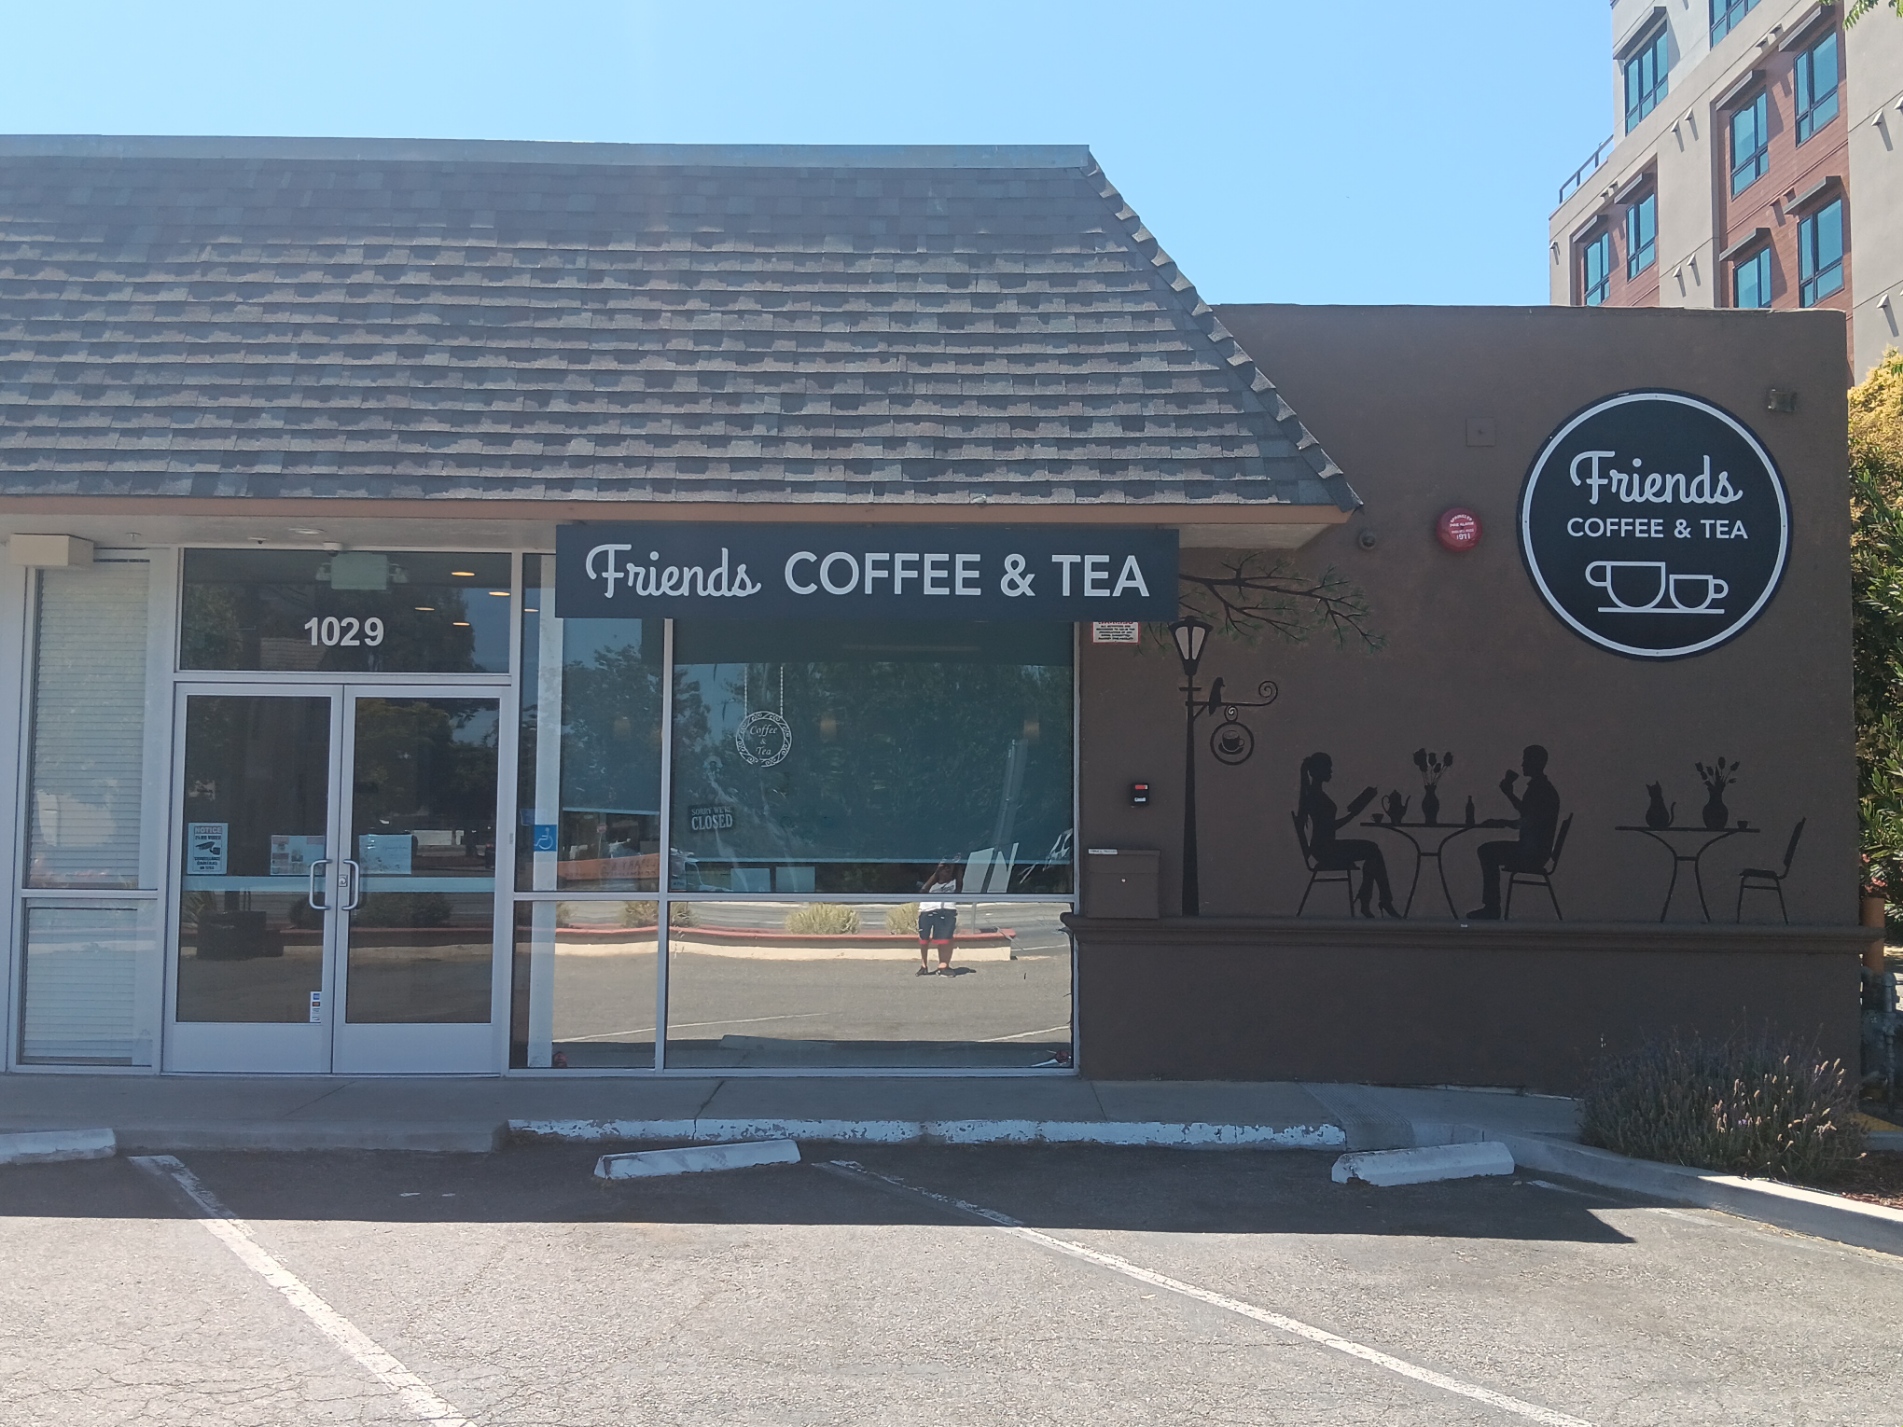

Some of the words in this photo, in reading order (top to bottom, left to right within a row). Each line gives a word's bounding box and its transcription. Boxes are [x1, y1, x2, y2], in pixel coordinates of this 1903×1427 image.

[1569, 450, 1744, 505] Friends
[1566, 517, 1665, 538] COFFEE
[1673, 518, 1692, 539] &
[1700, 519, 1749, 539] TEA
[585, 543, 762, 600] Friends
[784, 551, 982, 596] COFFEE
[1000, 553, 1037, 597] &
[1052, 554, 1150, 598] TEA
[304, 616, 385, 647] 1029
[749, 724, 778, 737] Coffee
[755, 746, 772, 756] Tea
[194, 826, 222, 834] NOTICE
[691, 813, 733, 831] CLOSED
